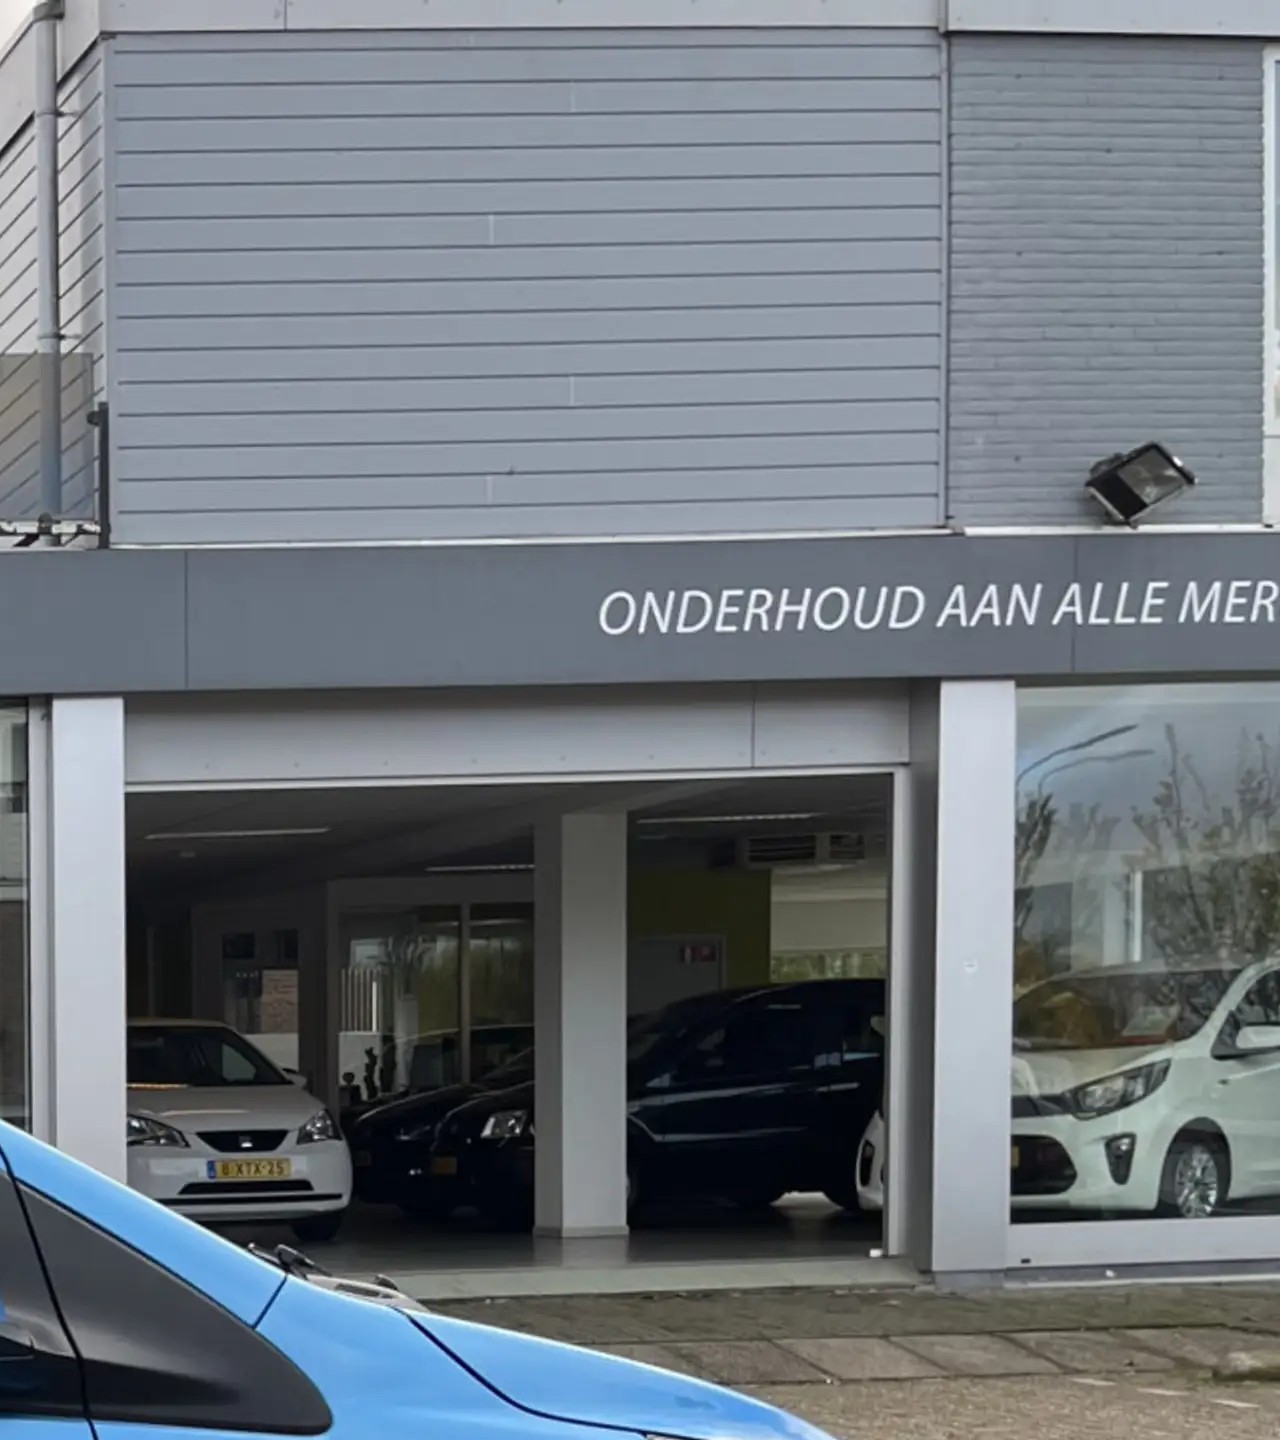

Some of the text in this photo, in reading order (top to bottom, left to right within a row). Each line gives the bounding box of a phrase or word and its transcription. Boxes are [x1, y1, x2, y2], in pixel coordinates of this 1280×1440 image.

[598, 579, 1279, 635] ONDERHOUD AAN ALLE MER
